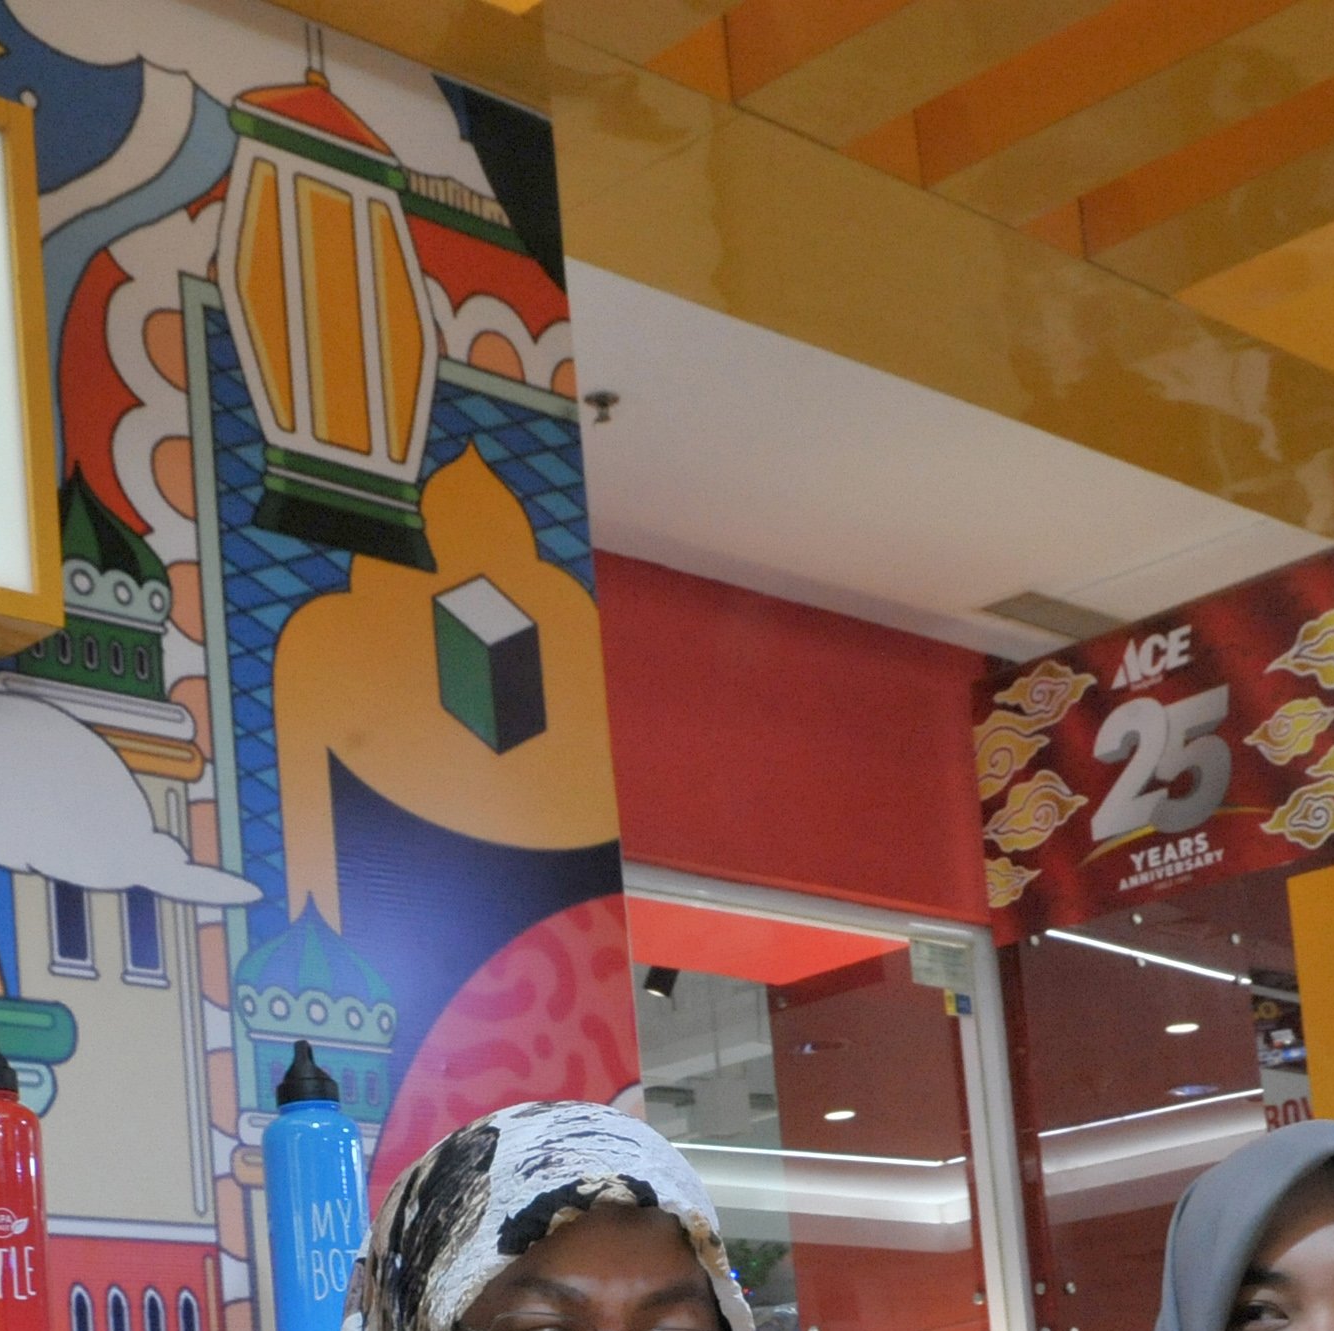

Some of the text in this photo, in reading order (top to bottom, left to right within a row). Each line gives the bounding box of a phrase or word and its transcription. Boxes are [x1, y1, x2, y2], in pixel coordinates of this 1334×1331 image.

[1111, 624, 1193, 690] ACE
[1091, 683, 1232, 842] 25
[1119, 849, 1225, 891] ANNIVERSARY
[1130, 832, 1210, 873] YEARS
[310, 1197, 353, 1245] MY
